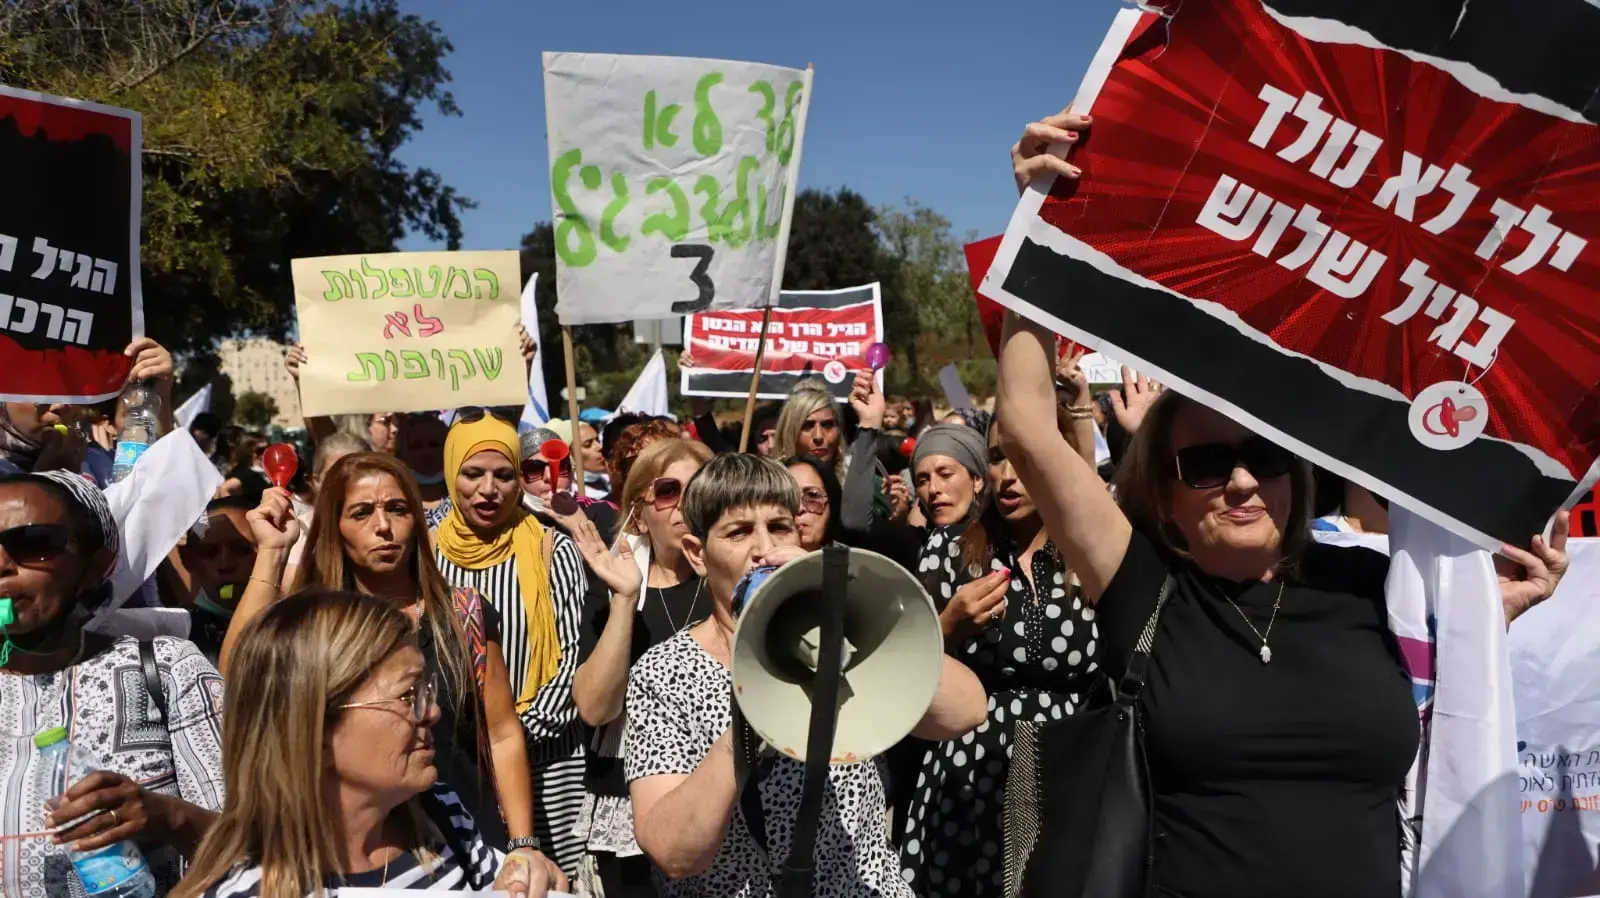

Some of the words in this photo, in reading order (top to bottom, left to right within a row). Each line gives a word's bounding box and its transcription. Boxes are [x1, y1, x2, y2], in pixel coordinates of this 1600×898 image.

[643, 71, 725, 157] לא
[1248, 83, 1384, 190] נולד
[1373, 151, 1480, 236] לא
[1195, 173, 1388, 299] שלוש
[1474, 197, 1588, 276] ילד
[30, 236, 118, 295] הגיל
[321, 256, 499, 302] המטפלות
[670, 244, 716, 313] 3
[383, 304, 444, 340] לא
[702, 316, 746, 333] הבטן
[750, 320, 784, 334] הא
[788, 322, 822, 337] הרך
[826, 322, 867, 336] הגיל
[1381, 258, 1516, 369] בגיל
[779, 337, 808, 352] של
[813, 341, 860, 356] הרכה
[347, 347, 503, 391] שקופות
[1525, 752, 1581, 768] האשה
[1561, 771, 1600, 792] דתית
